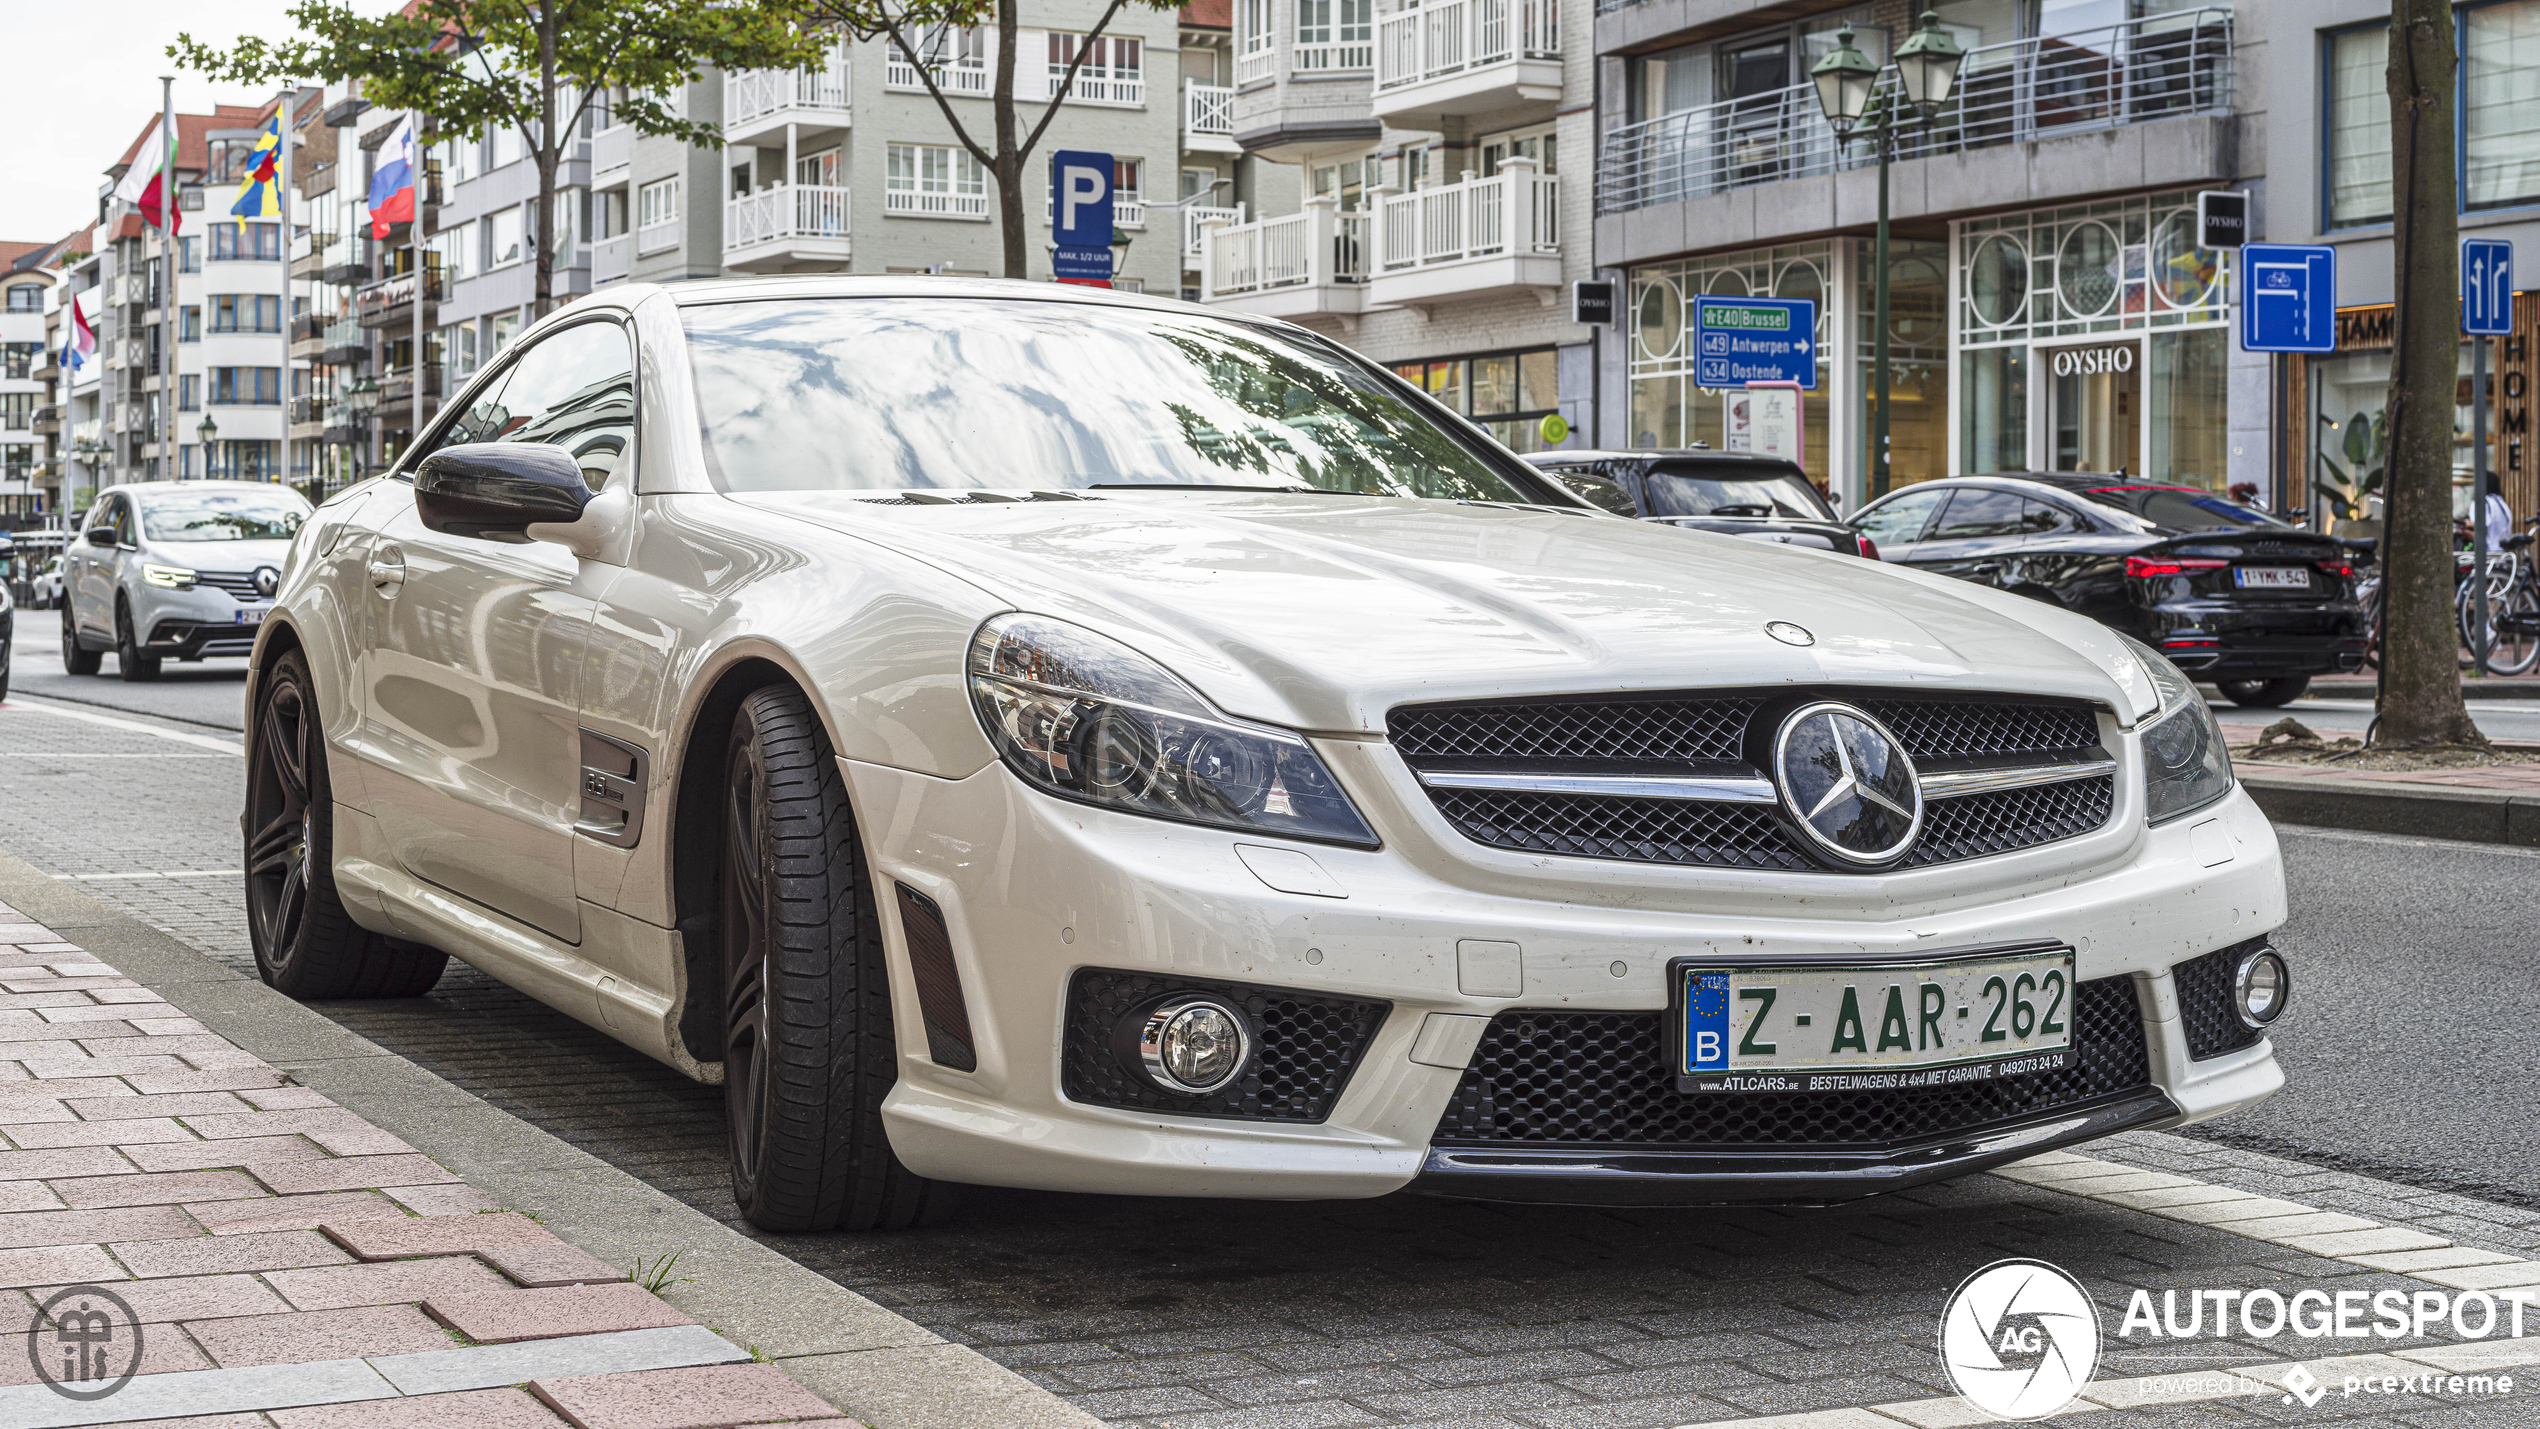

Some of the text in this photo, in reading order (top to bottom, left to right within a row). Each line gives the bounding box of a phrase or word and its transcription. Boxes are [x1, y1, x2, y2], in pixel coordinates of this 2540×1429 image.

[1062, 165, 1106, 230] P
[2206, 215, 2243, 229] OYSHO
[1080, 252, 1093, 262] 1/2
[1093, 253, 1111, 262] UUR
[1717, 309, 1786, 327] E40 Brussel
[1731, 336, 1790, 358] Antwerpen
[1732, 362, 1783, 379] Oostende
[2054, 346, 2133, 377] OYSHO
[2503, 334, 2527, 471] HOME
[1696, 1031, 1721, 1062] B
[1809, 1075, 1897, 1090] BESTELWAGENS
[1899, 1076, 1907, 1087] &
[1908, 1073, 1926, 1086] 4x4
[1927, 1071, 1946, 1084] MET
[1948, 1065, 1992, 1081] GARANTIE
[2000, 1059, 2038, 1076] 0492/73
[2039, 1056, 2051, 1070] 24
[2052, 1054, 2064, 1067] 24
